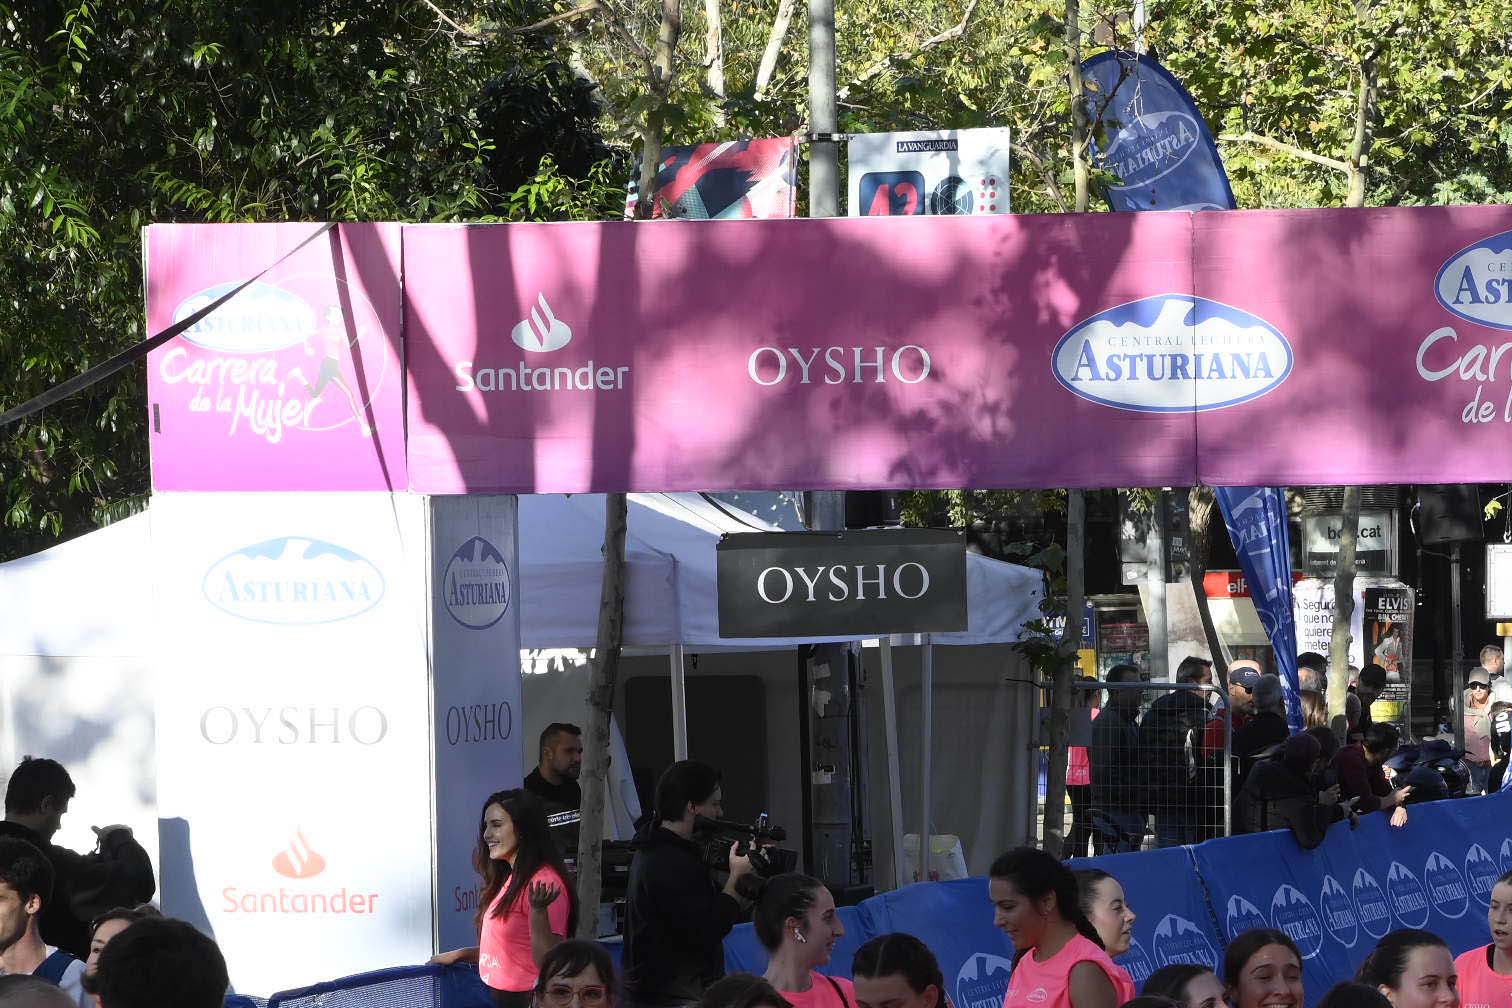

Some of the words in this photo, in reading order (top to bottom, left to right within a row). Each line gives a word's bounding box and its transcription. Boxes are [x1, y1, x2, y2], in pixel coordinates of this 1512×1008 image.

[907, 140, 957, 151] VANGUARDIA
[1108, 335, 1183, 347] CENTRAL
[160, 347, 278, 385] Carrera
[455, 361, 629, 392] Santander
[748, 345, 931, 386] OYSHO
[1071, 338, 1274, 382] ASTURIANA
[189, 384, 212, 412] de
[216, 386, 232, 412] la
[229, 383, 323, 443] Mujer
[1462, 387, 1496, 424] de
[218, 571, 371, 600] ASTURIANA
[448, 571, 506, 606] ASTURIANA
[758, 562, 930, 604] OYSHO
[1304, 615, 1320, 625] que
[1378, 598, 1409, 610] ELVIS
[199, 705, 388, 745] OYSHO
[445, 701, 512, 745] OYSHO
[222, 887, 379, 914] Santander
